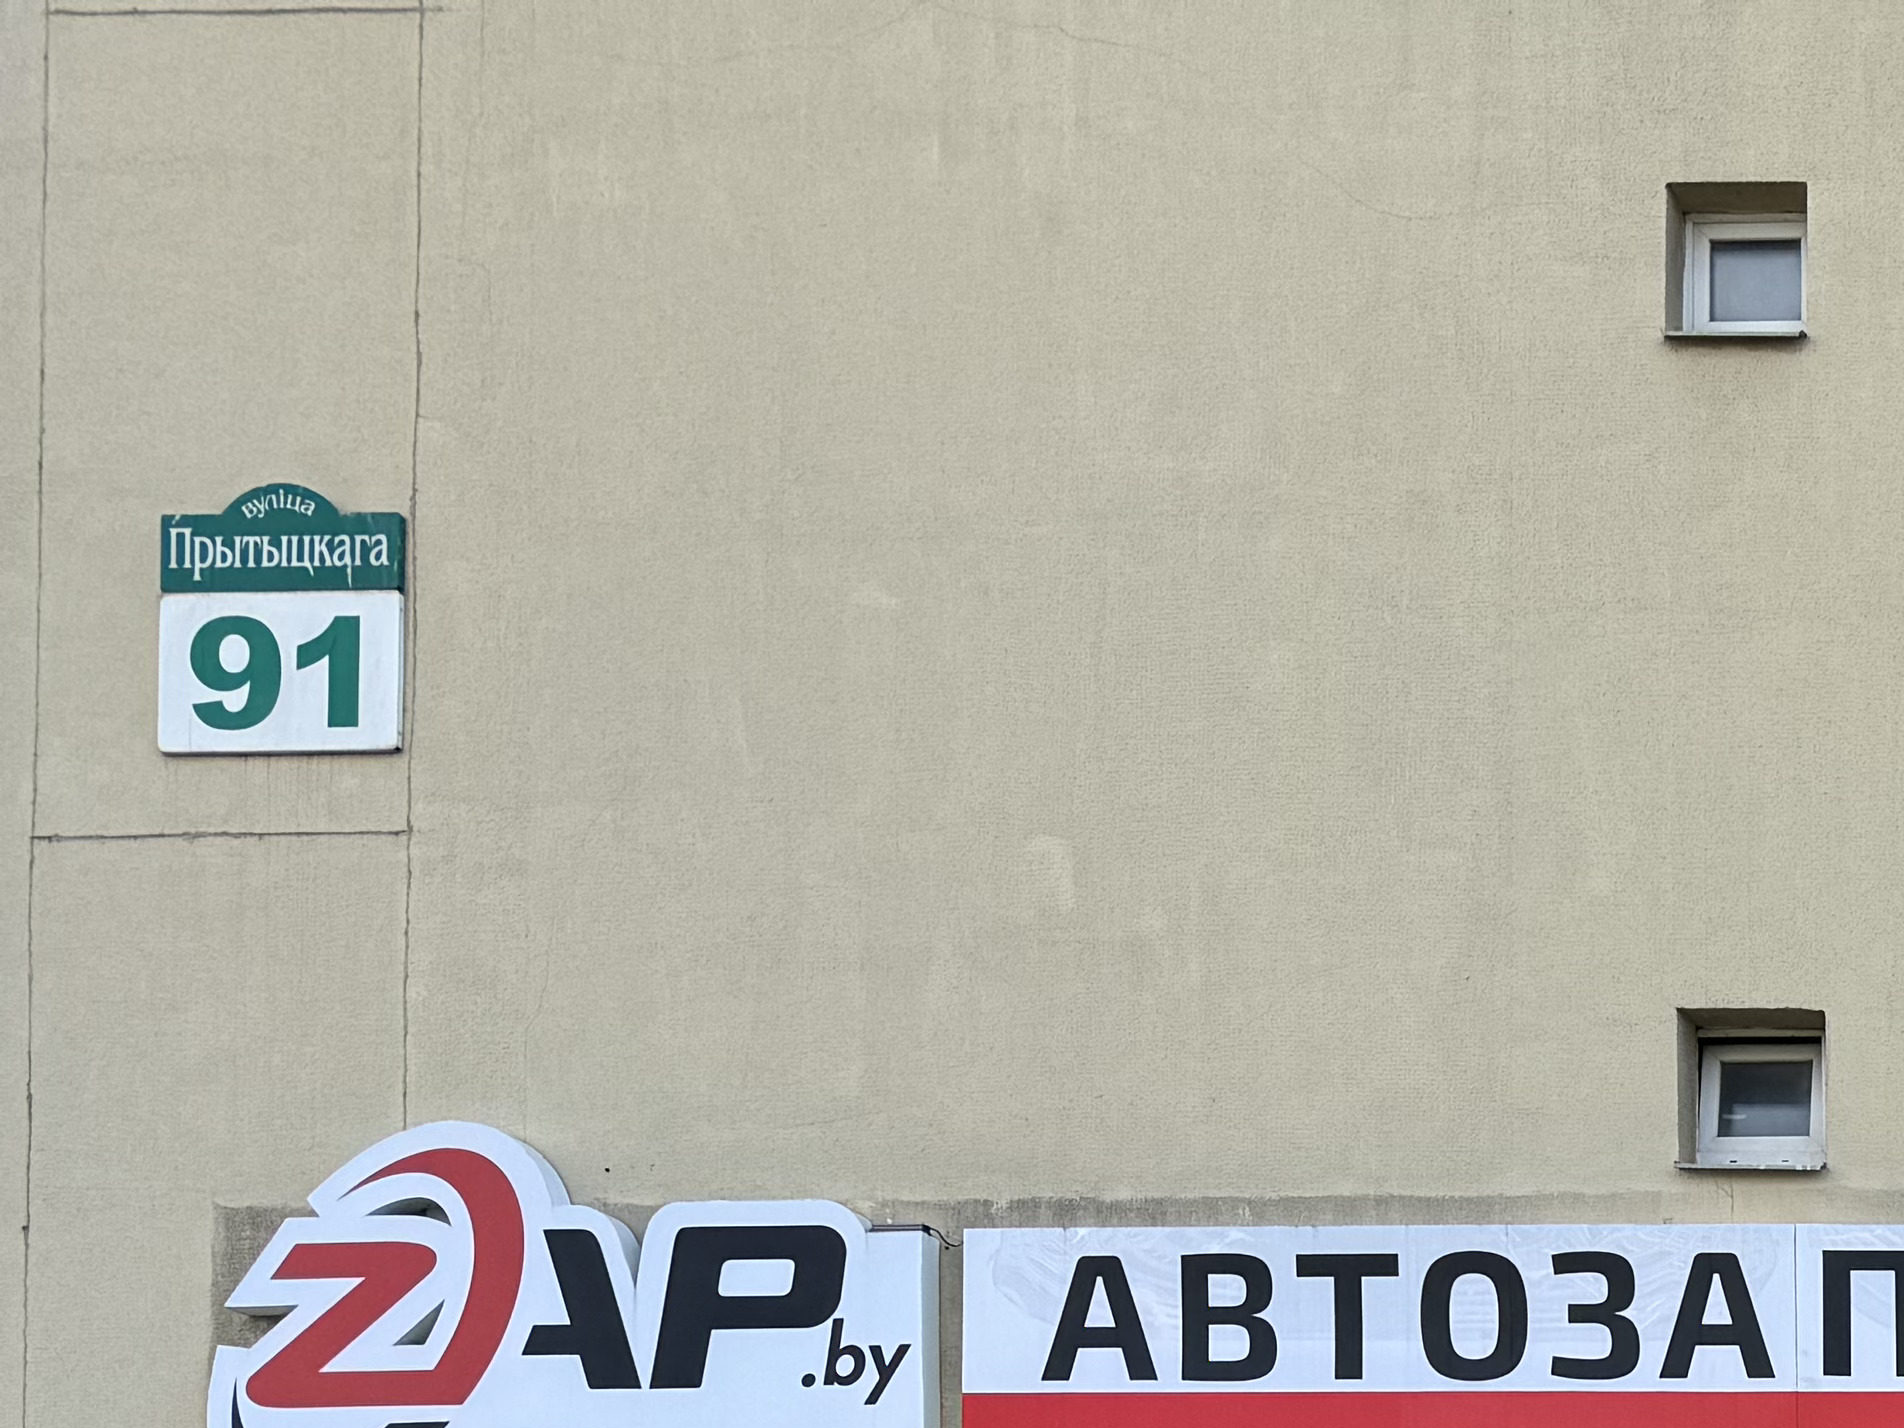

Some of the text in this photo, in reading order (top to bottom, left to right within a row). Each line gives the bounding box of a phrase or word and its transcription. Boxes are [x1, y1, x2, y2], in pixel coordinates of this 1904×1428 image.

[241, 488, 316, 519] вуліца
[168, 527, 390, 581] Прытыцкага
[190, 615, 361, 731] 91
